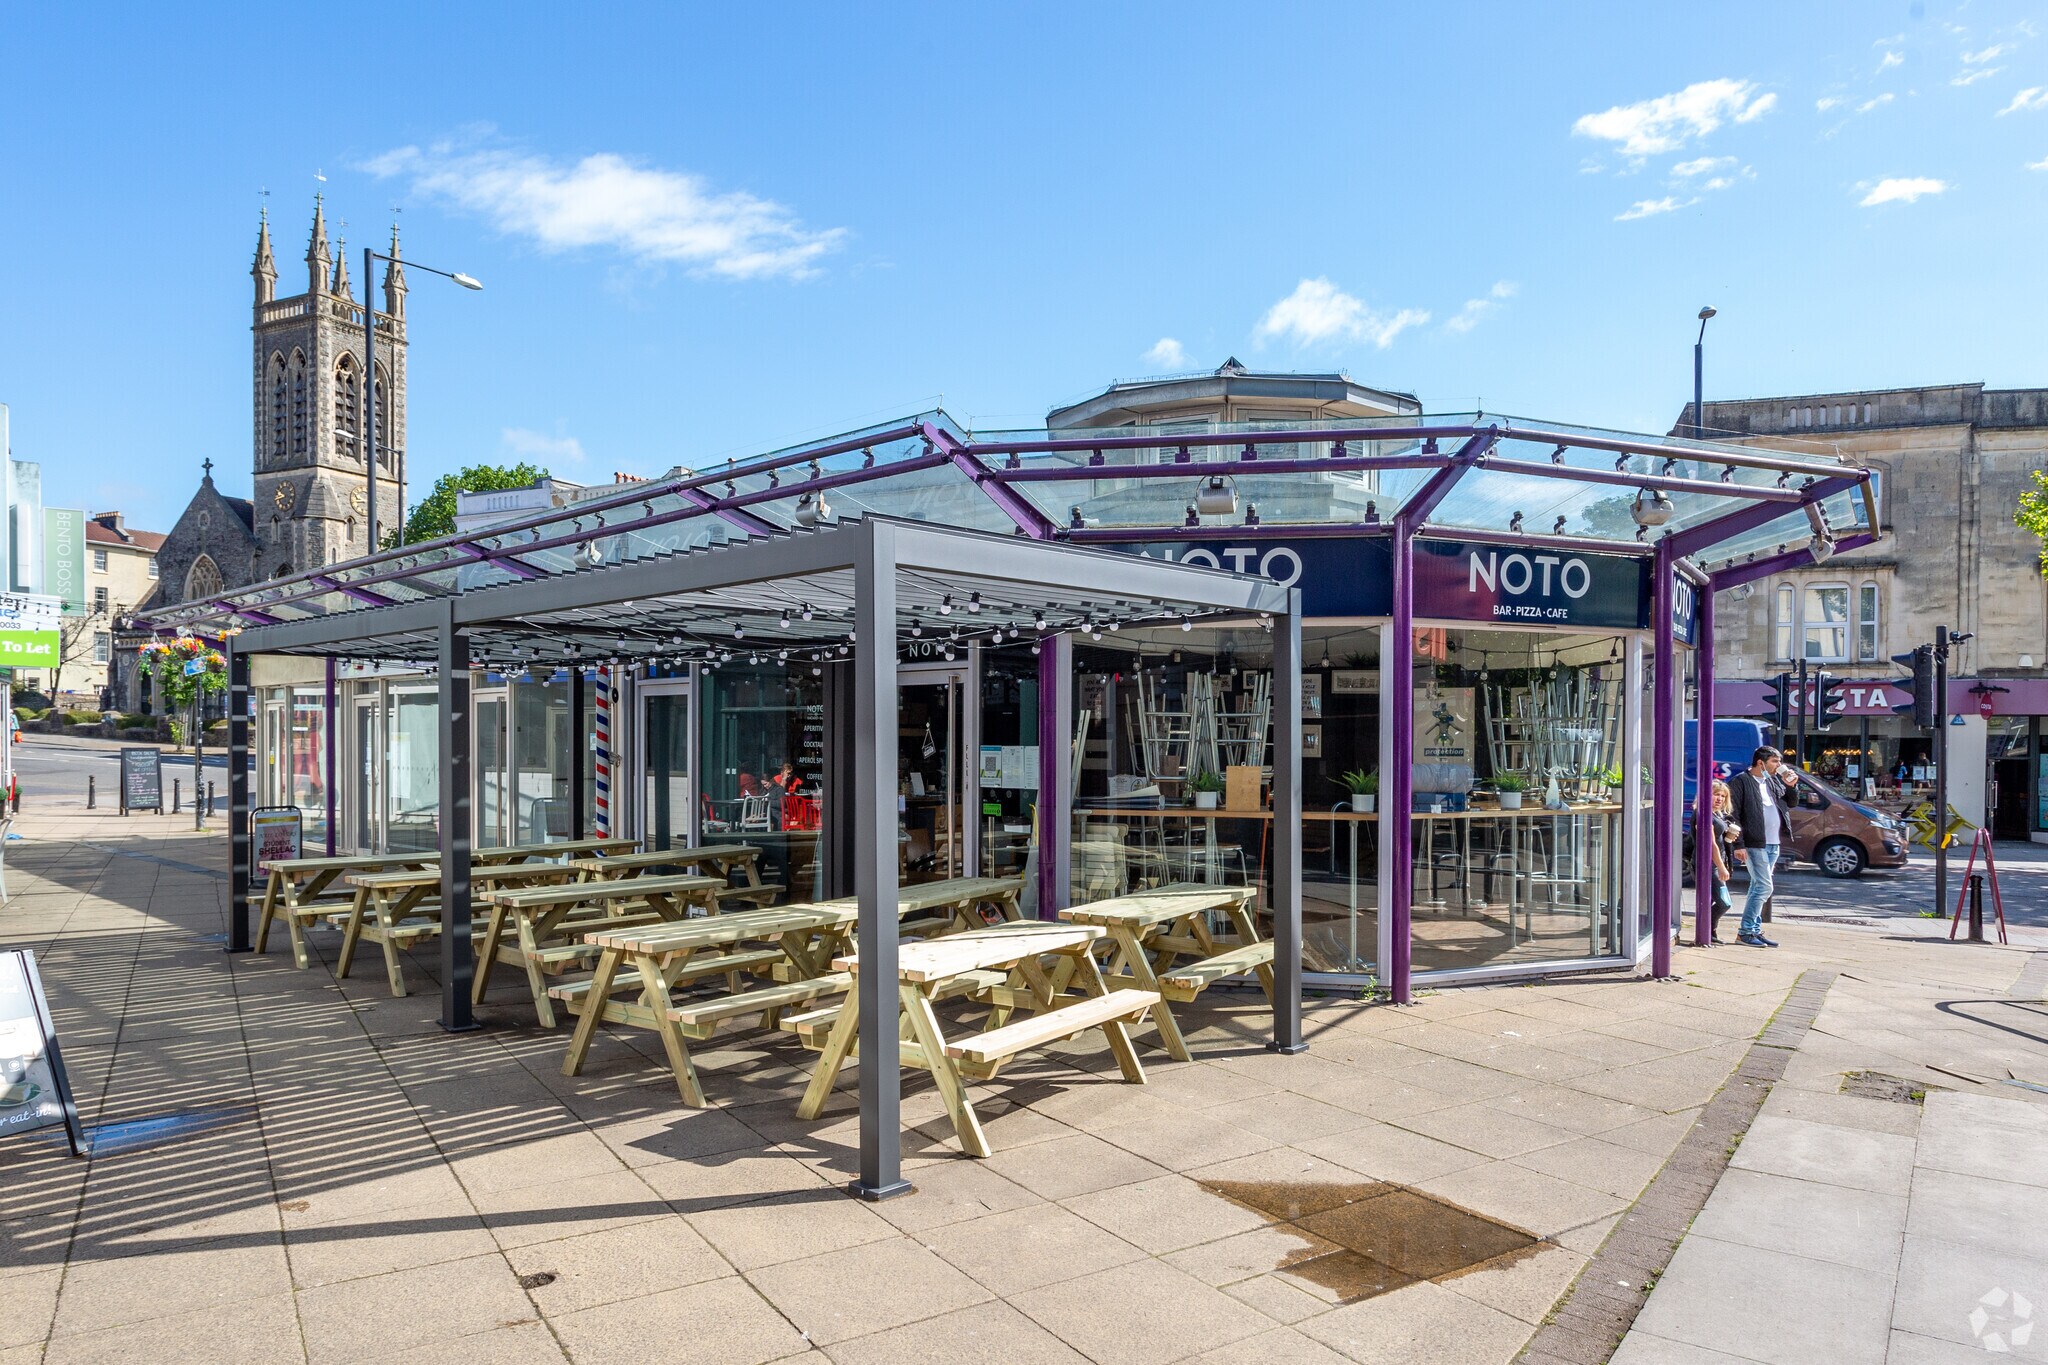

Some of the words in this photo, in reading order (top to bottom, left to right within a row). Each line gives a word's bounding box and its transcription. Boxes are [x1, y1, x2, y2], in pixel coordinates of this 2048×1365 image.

[57, 512, 72, 556] BENTO
[57, 560, 72, 594] BOSS
[1469, 551, 1591, 599] NOTO
[2, 641, 22, 653] To
[26, 642, 51, 655] Let
[258, 845, 297, 856] SHELLAC
